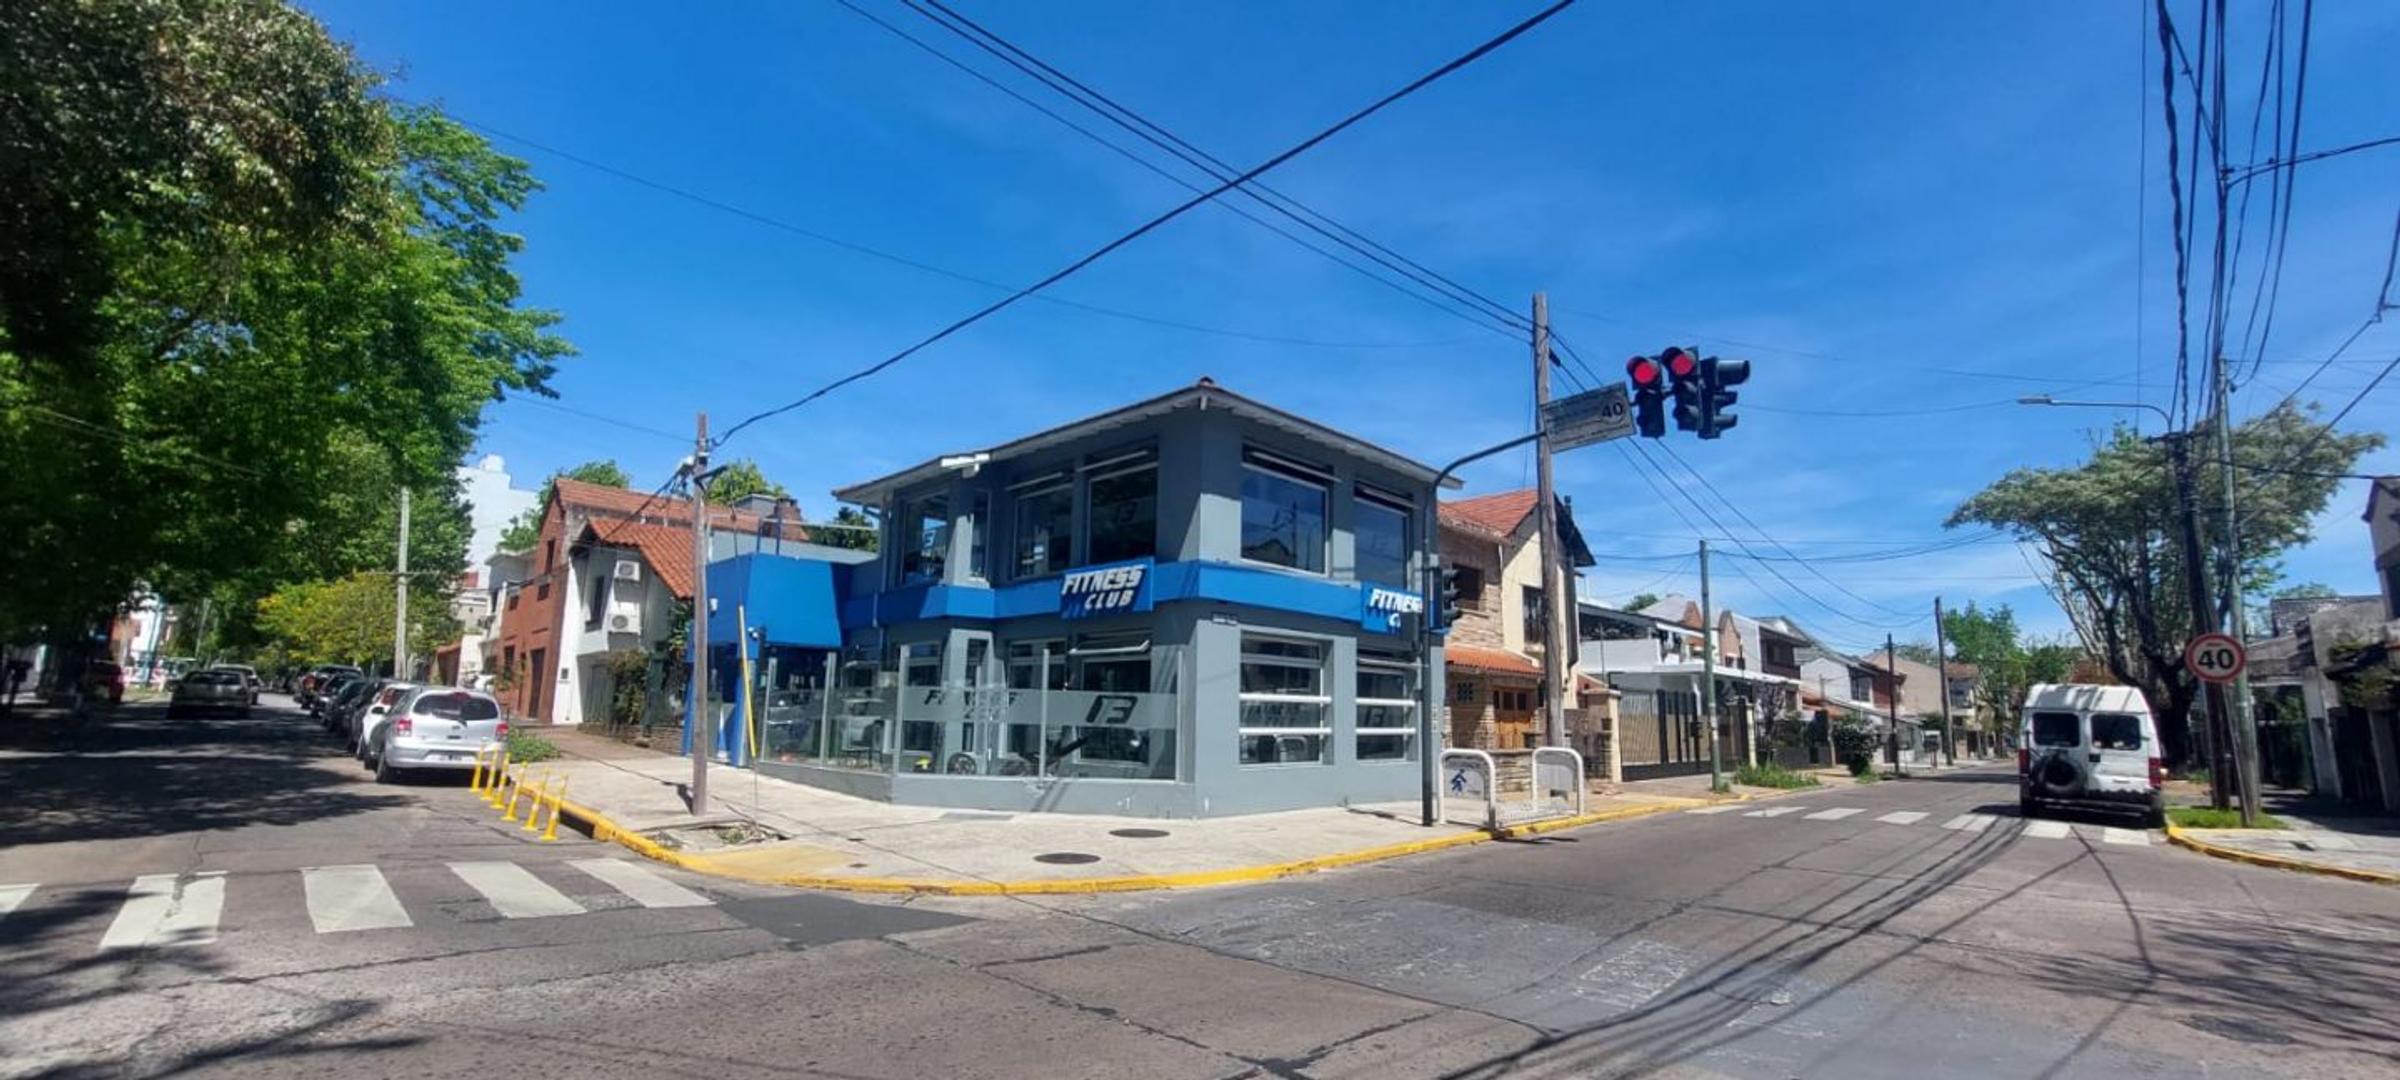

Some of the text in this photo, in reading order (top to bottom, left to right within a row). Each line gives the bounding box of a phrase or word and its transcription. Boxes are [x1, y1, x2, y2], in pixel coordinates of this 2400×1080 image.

[1602, 402, 1624, 417] 40
[1061, 564, 1147, 595] FITNESS
[1084, 590, 1135, 610] CLUB
[1369, 588, 1423, 613] FITNES
[2198, 649, 2235, 669] 40
